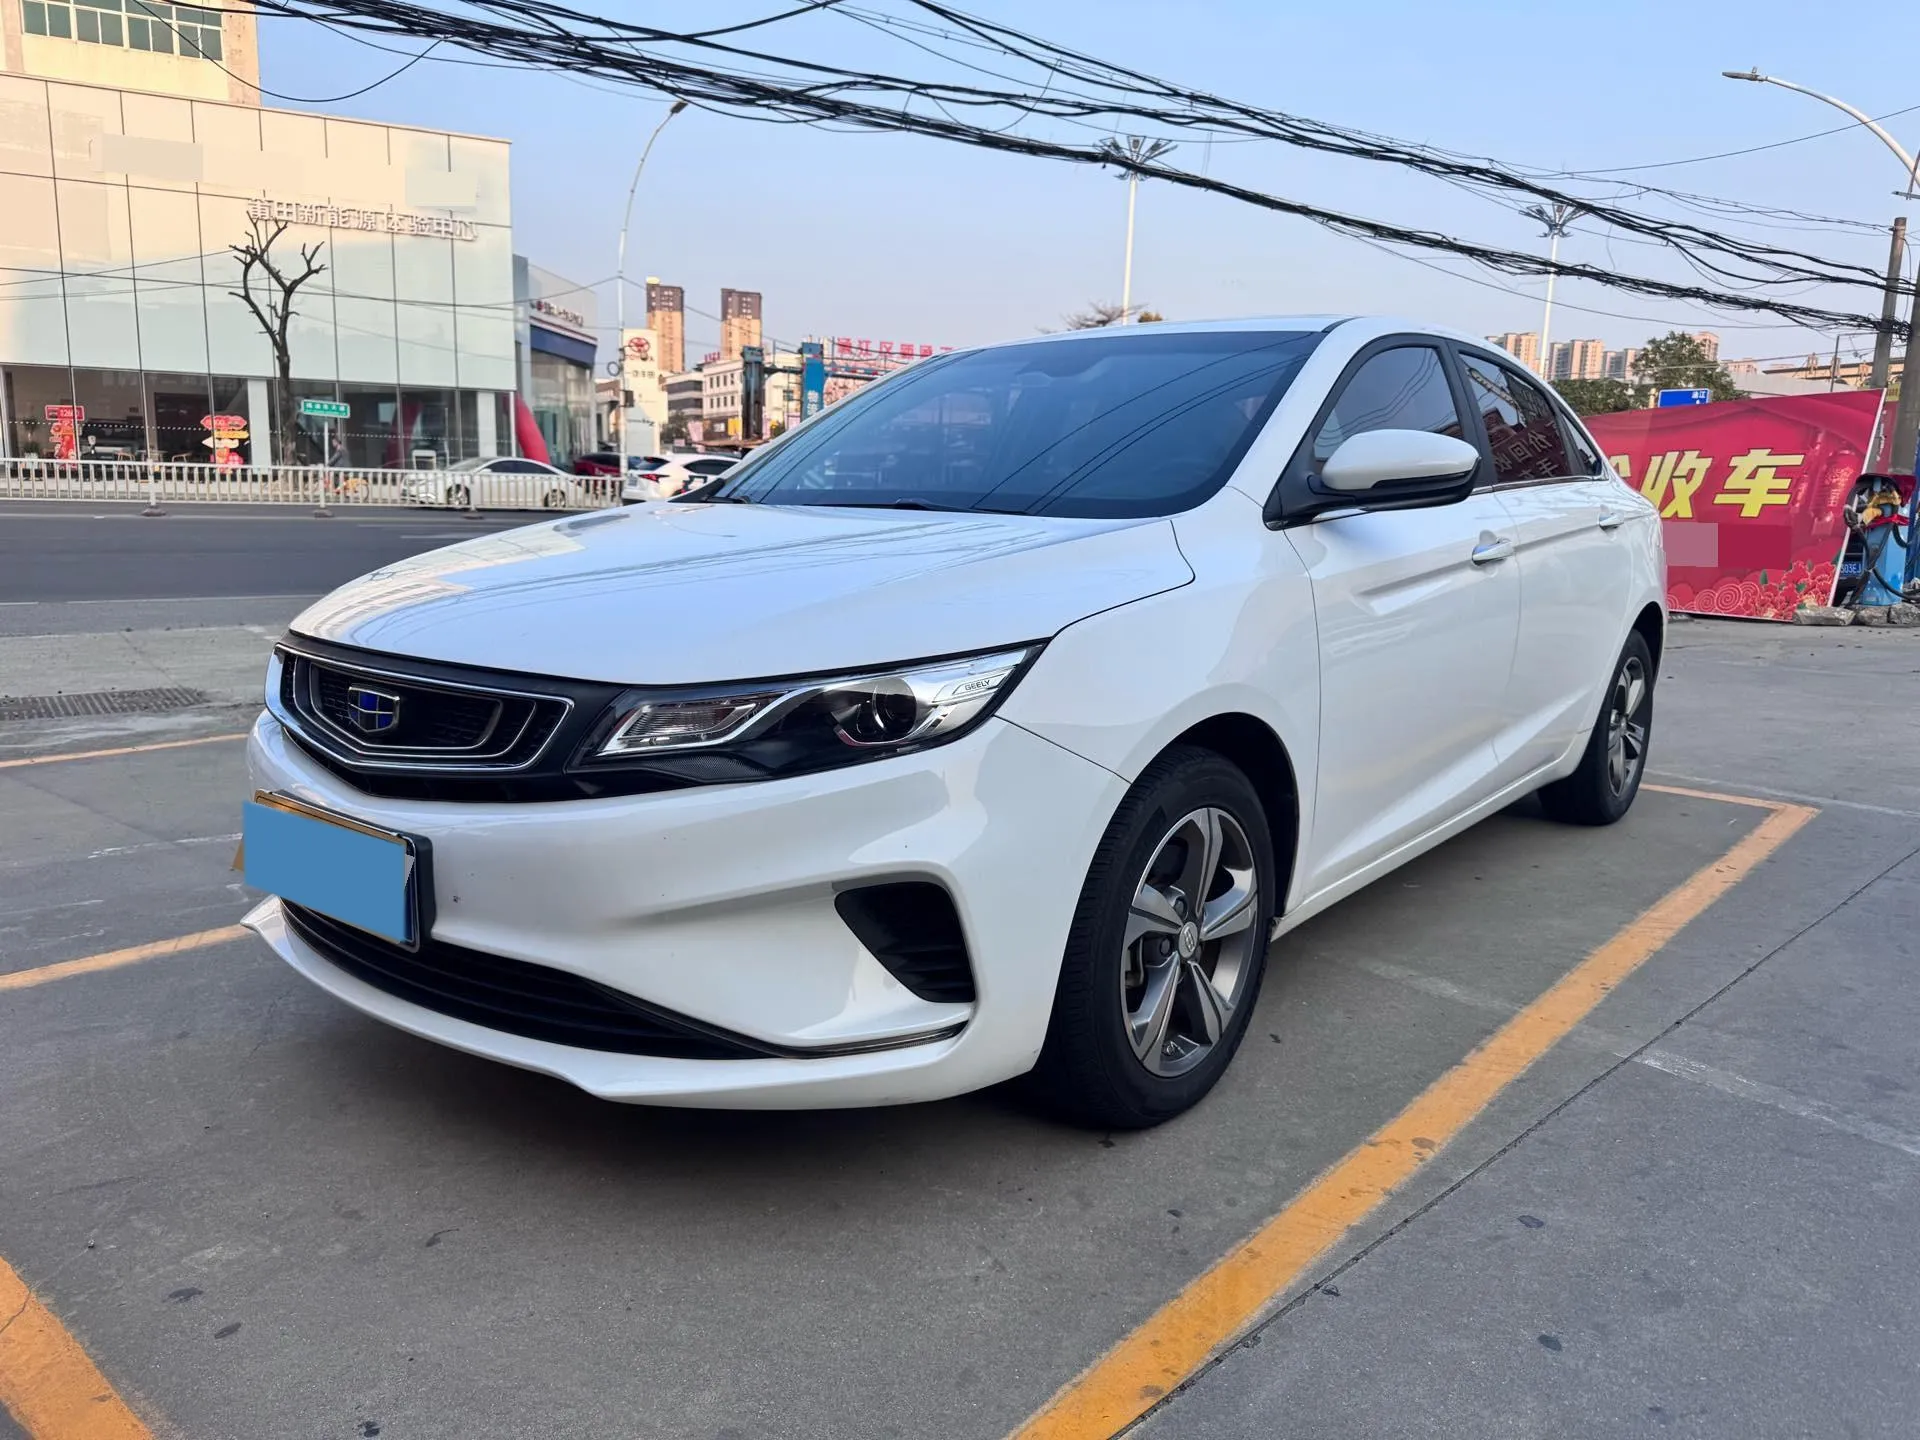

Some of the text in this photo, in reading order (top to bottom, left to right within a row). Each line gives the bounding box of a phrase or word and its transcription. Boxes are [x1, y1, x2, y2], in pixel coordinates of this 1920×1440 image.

[249, 198, 478, 241] 莆田新能源体验中心
[964, 680, 991, 691] GEELY
